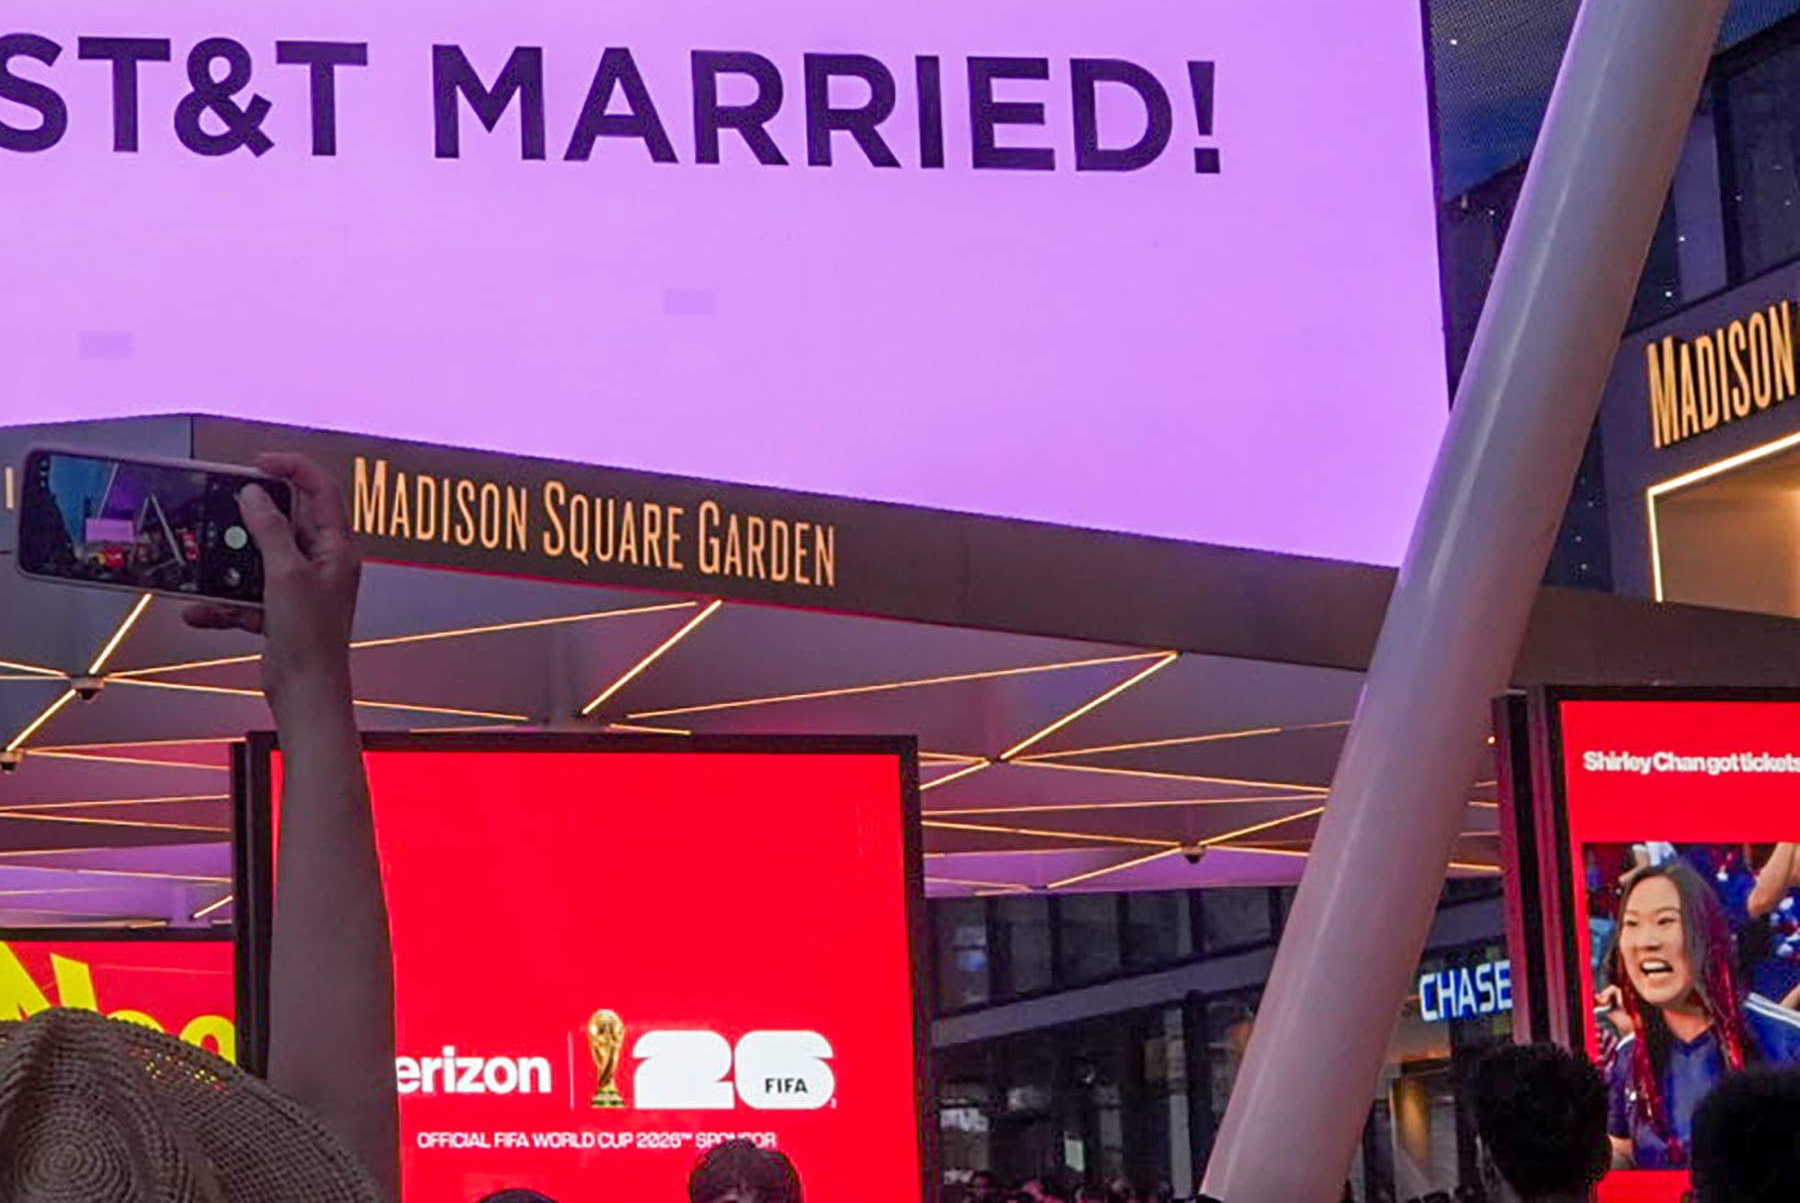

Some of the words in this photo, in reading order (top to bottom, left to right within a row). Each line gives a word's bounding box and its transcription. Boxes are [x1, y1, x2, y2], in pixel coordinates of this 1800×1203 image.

[431, 43, 1221, 175] MARRIED!
[1646, 299, 1797, 449] MADISON
[352, 456, 528, 551] MADISON
[543, 480, 685, 570] SQUARE
[698, 500, 834, 586] GARDEN
[1583, 750, 1650, 775] Shirley
[1418, 959, 1513, 1022] CHASE
[395, 1045, 553, 1094] erizon
[764, 1077, 809, 1094] FIFA
[416, 1131, 492, 1149] OFFICIAL
[493, 1131, 531, 1149] FIFA
[532, 1131, 596, 1149] WORLD
[596, 1131, 635, 1149] CUP
